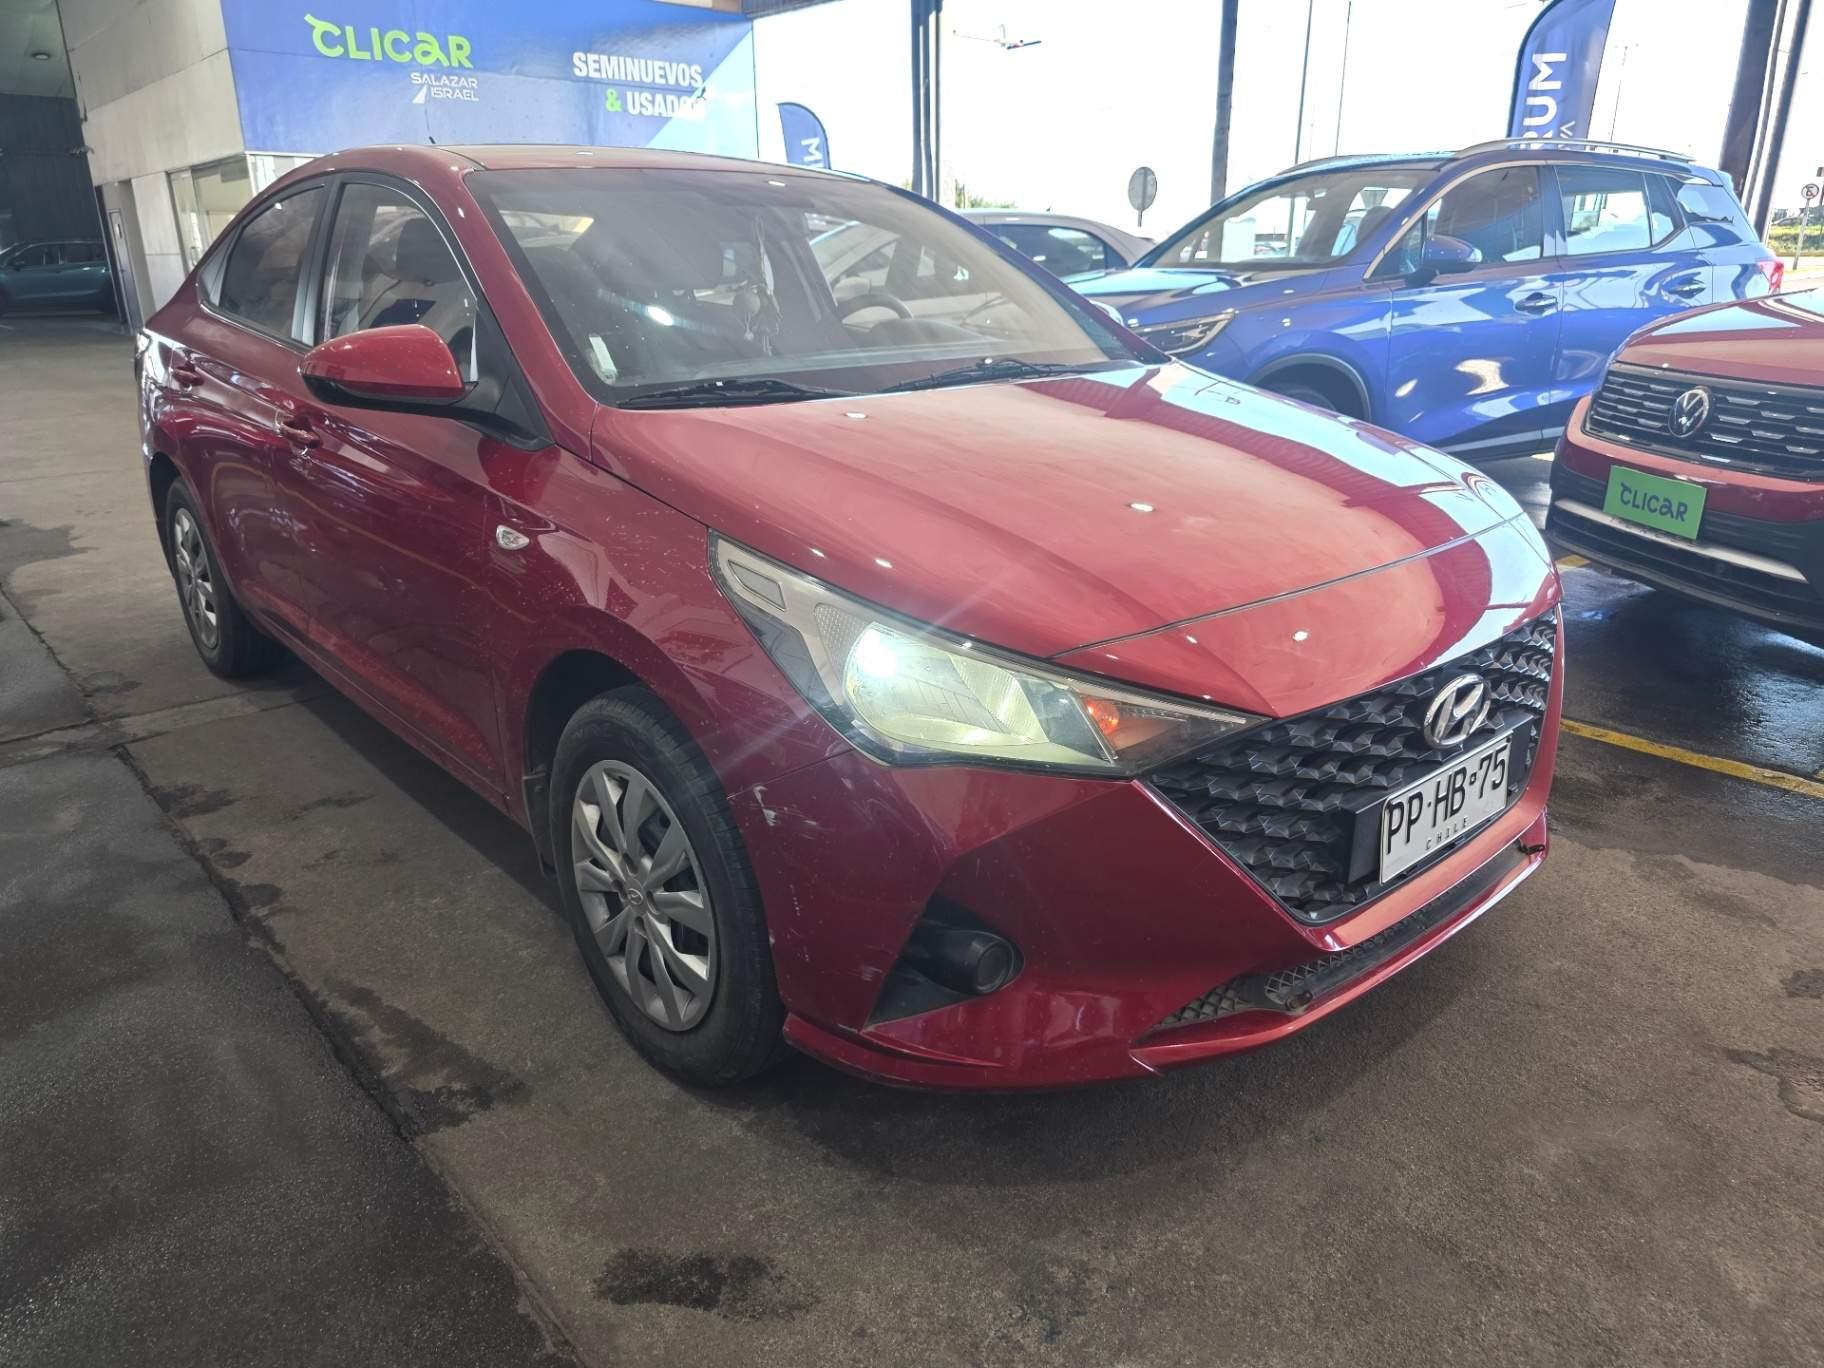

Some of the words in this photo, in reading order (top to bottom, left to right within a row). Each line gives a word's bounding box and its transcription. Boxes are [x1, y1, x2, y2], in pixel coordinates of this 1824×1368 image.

[410, 72, 478, 89] SALAZAR
[572, 51, 704, 88] SEMINUEVOS
[430, 86, 480, 102] ISRAEL
[605, 88, 622, 112] &
[626, 91, 706, 119] USAD
[1425, 816, 1468, 851] CHILE
